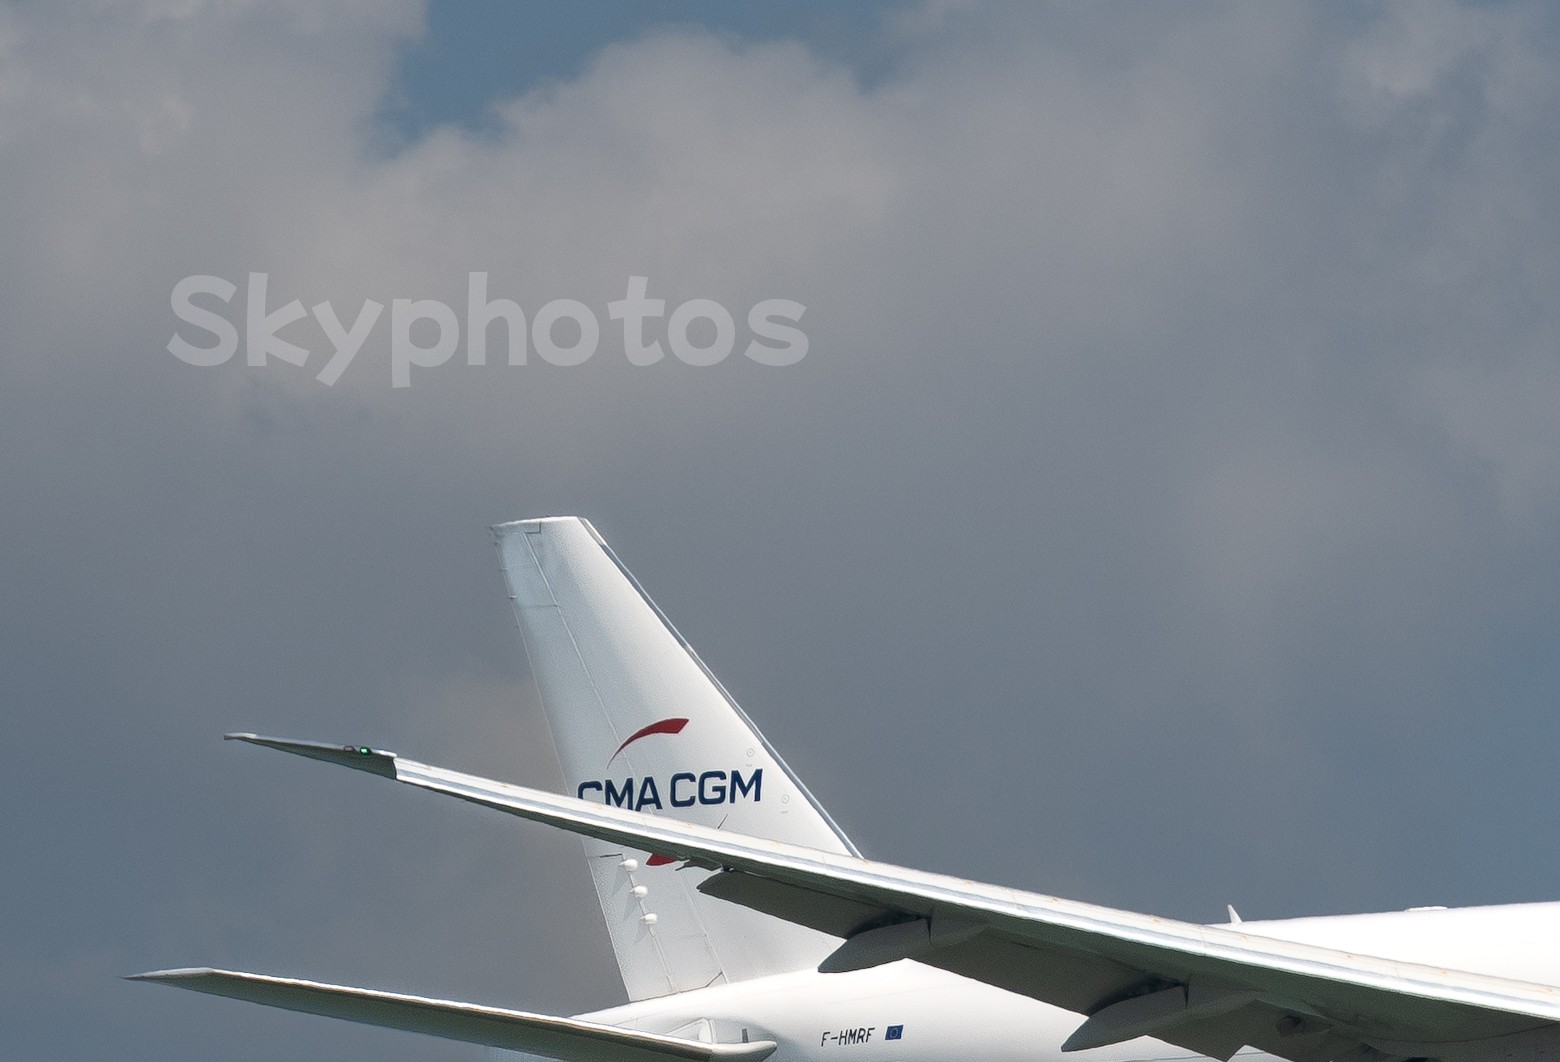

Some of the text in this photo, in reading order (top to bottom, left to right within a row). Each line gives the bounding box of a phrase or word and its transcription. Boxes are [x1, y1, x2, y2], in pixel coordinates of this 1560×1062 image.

[577, 768, 763, 812] CMA CGM
[820, 1027, 876, 1047] F-HMRF
